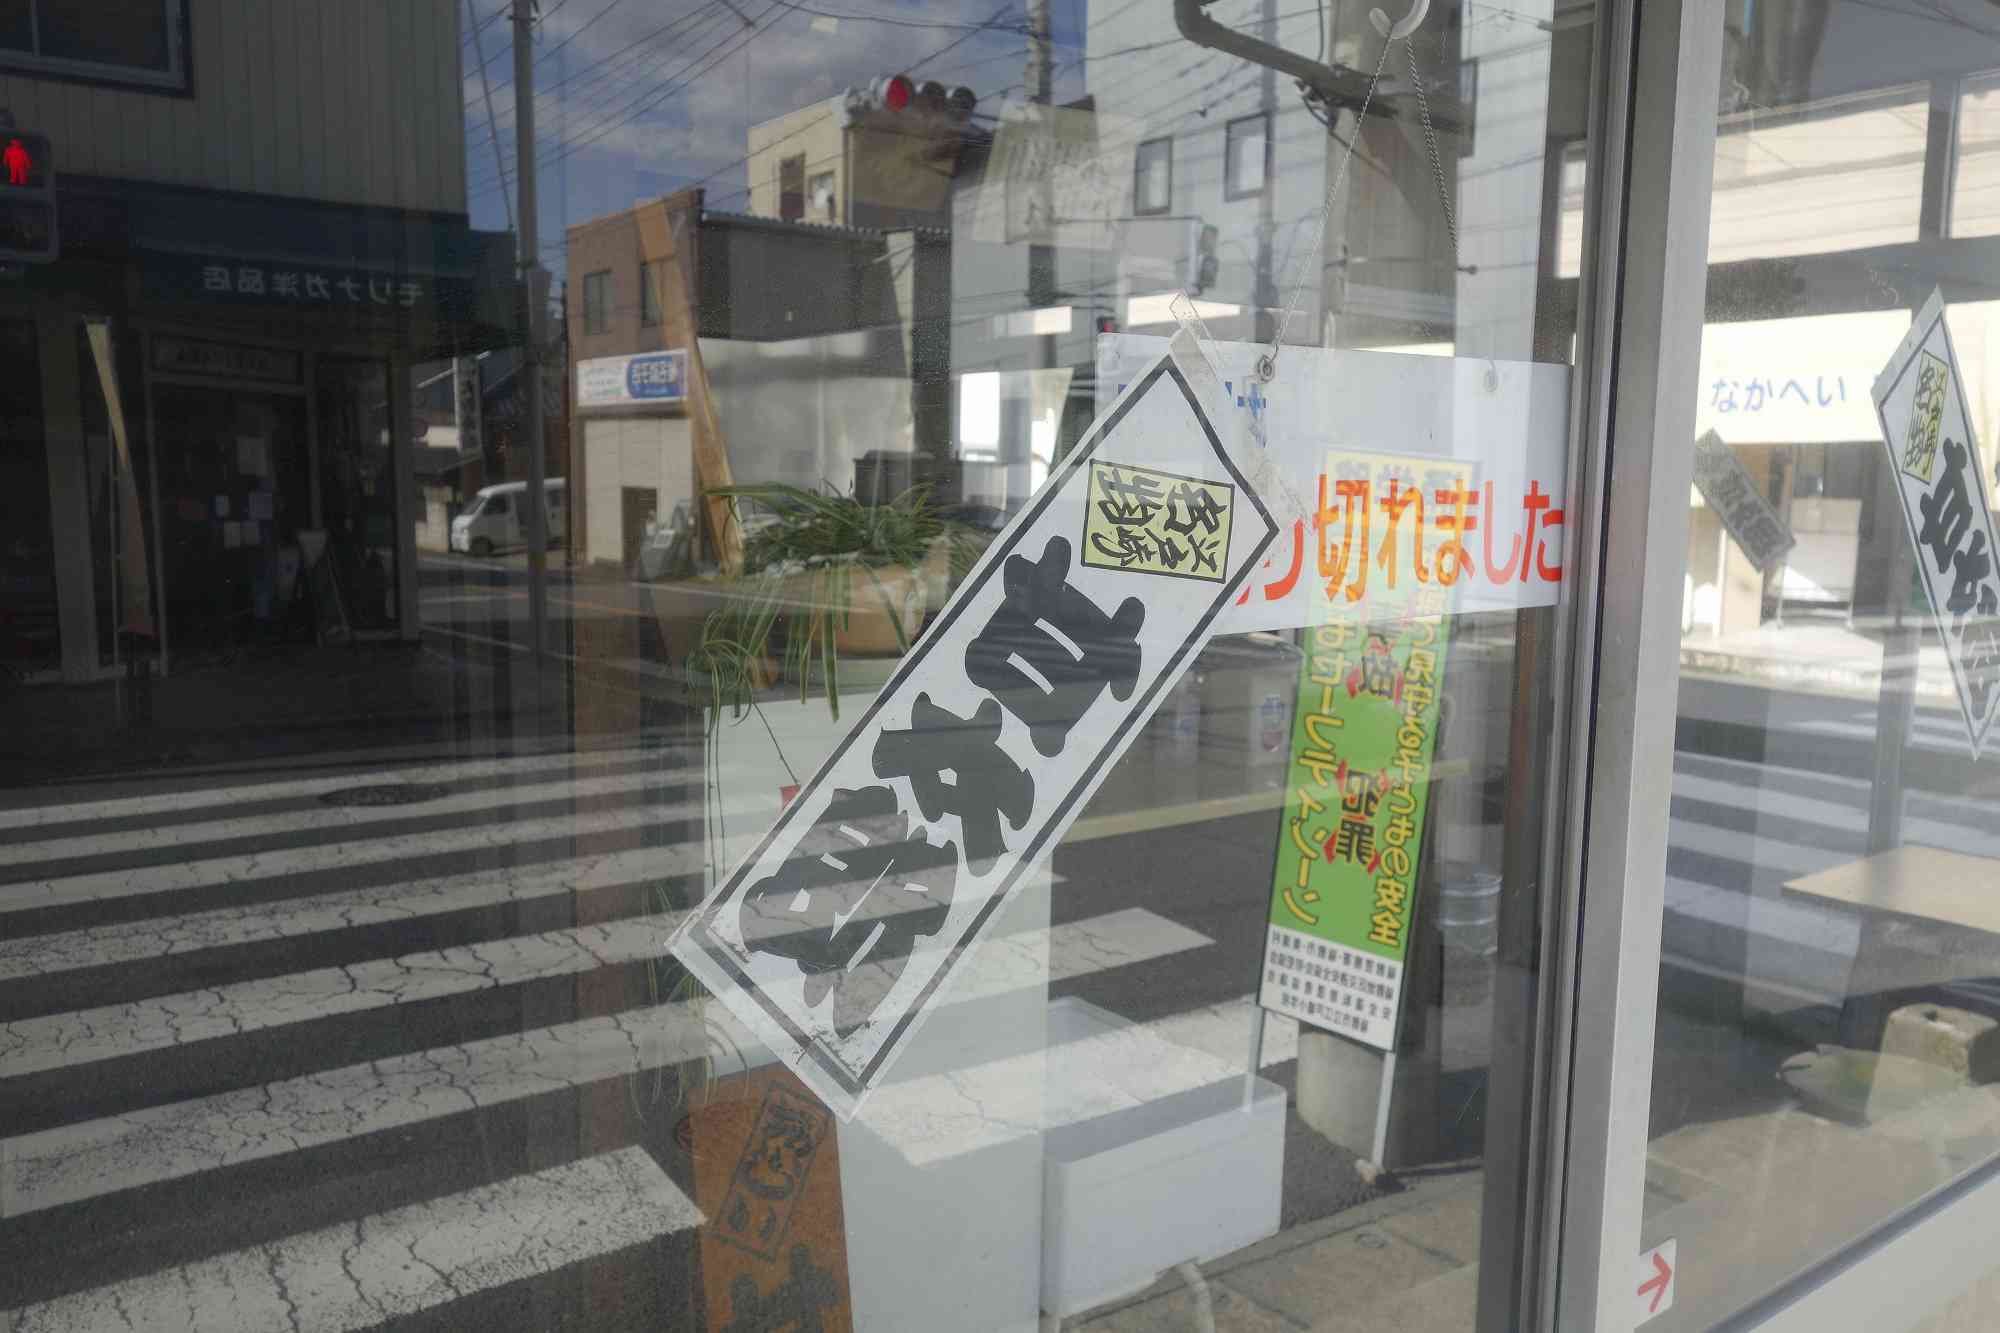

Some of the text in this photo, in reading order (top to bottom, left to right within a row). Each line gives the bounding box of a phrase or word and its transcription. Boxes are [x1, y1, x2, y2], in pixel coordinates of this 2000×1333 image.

[1711, 375, 1847, 412] なかへい
[1240, 474, 1565, 603] り切れました
